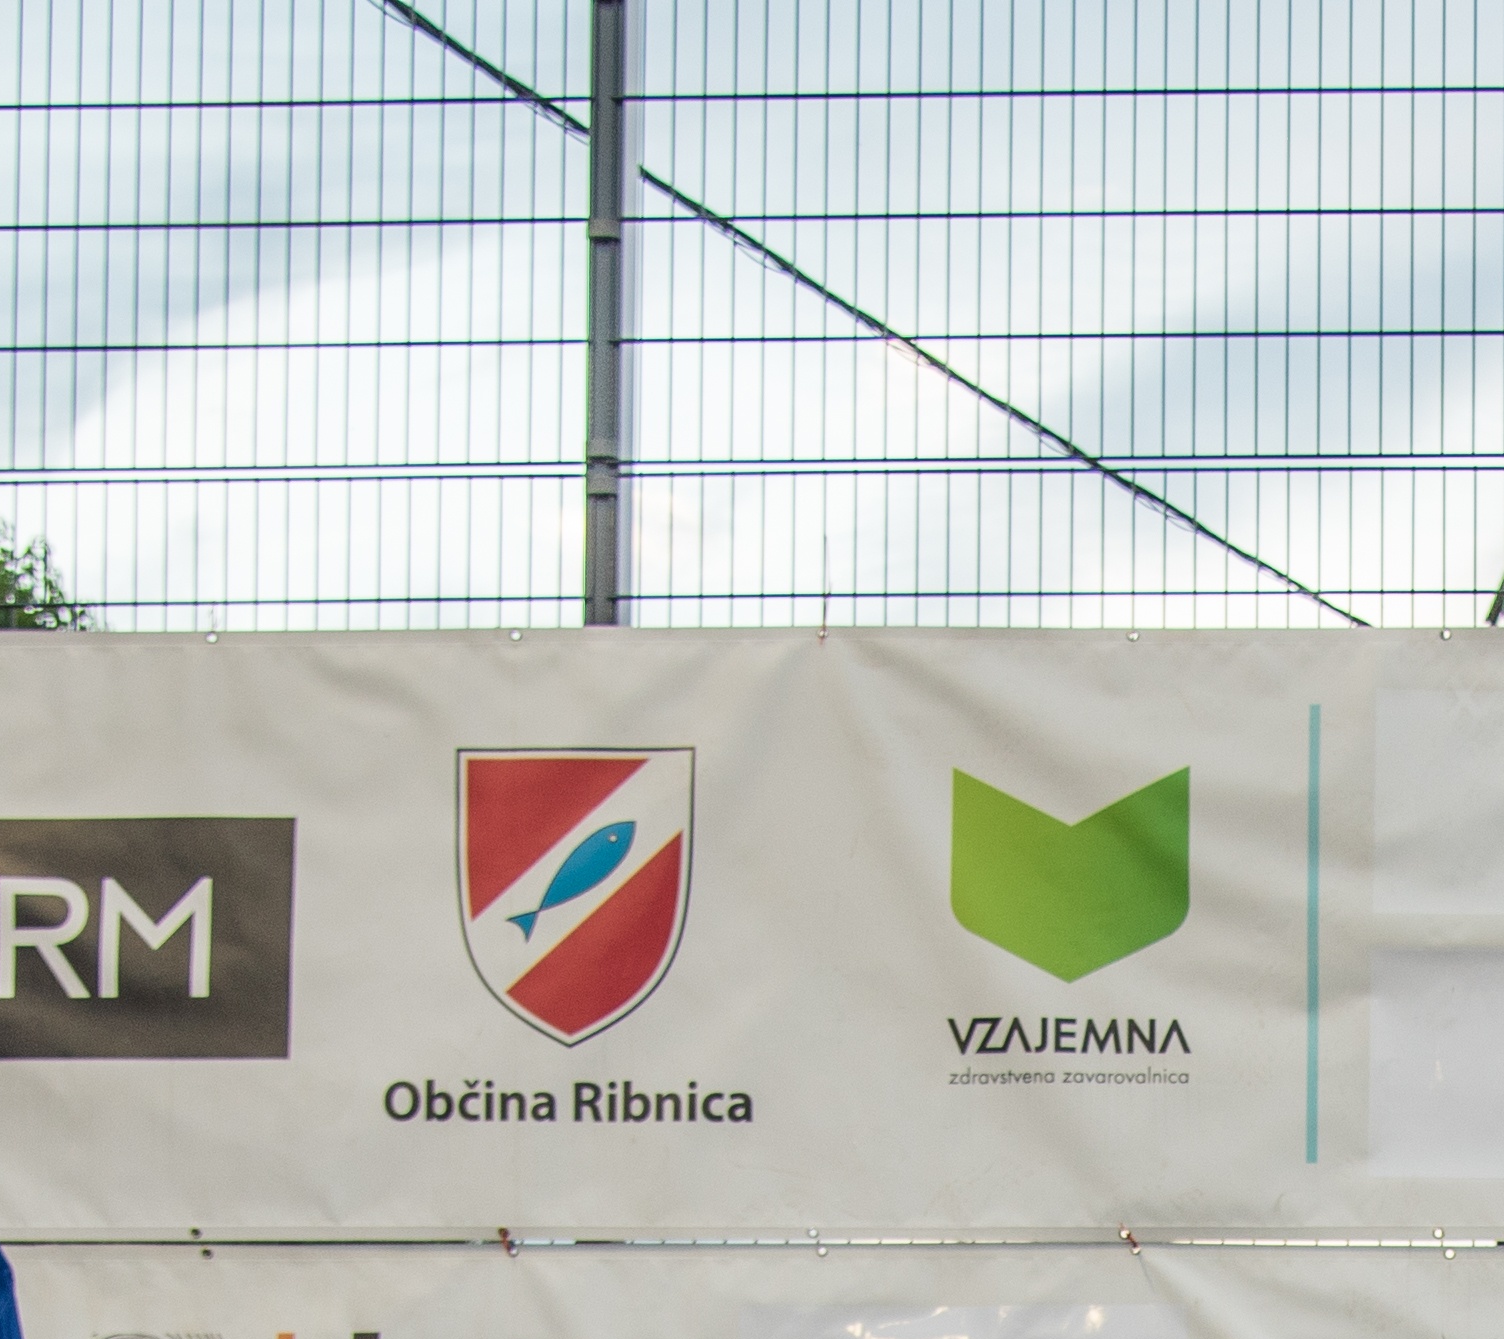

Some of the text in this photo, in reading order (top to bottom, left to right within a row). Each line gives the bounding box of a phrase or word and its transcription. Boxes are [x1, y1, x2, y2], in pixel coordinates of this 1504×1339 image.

[947, 1016, 1192, 1056] VZAJEMNA
[948, 1066, 1190, 1086] zdravstvena zavarovalnica
[382, 1077, 755, 1124] Občina Ribnica
